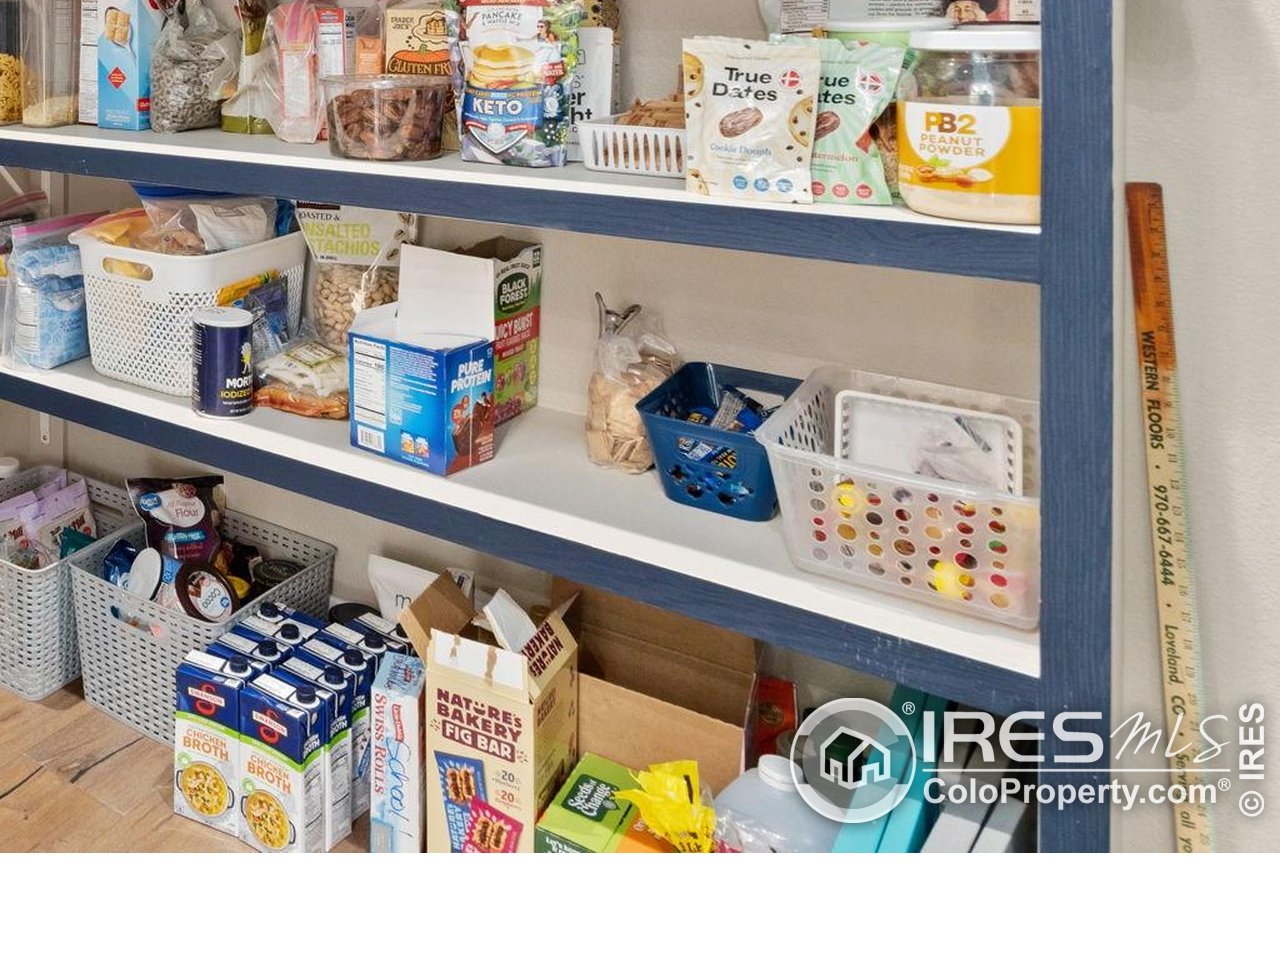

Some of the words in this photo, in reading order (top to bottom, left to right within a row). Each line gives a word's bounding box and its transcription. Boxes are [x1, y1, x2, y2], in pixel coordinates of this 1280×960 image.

[481, 11, 522, 20] PANCAKE
[388, 58, 432, 74] GLUTEN
[724, 66, 772, 84] True
[819, 75, 850, 88] rue
[712, 82, 778, 102] Dates
[472, 98, 523, 115] KETO
[924, 111, 977, 135] PB2
[920, 134, 984, 146] PEANUT
[919, 143, 985, 157] POWDER
[299, 211, 332, 221] OASTED
[305, 222, 370, 239] NSALTED
[501, 277, 527, 294] BLACK
[499, 286, 529, 306] FOREST
[457, 359, 485, 377] PURE
[1141, 330, 1159, 392] WESTERN
[225, 376, 253, 389] MOR
[450, 368, 492, 393] PROTEIN
[1147, 398, 1165, 450] FLOORS
[174, 507, 199, 518] Flour
[1153, 484, 1175, 586] 970-667-6444
[436, 702, 523, 744] BAKERY
[185, 727, 228, 748] CHICKEN
[444, 722, 472, 746] FIG
[479, 732, 513, 760] BAR
[182, 736, 230, 762] BROTH
[250, 753, 290, 779] CHICKEN
[247, 760, 292, 795] BROTH
[500, 770, 515, 782] 20
[500, 790, 515, 803] 20
[568, 781, 593, 808] Seeds
[579, 783, 611, 817] Change
